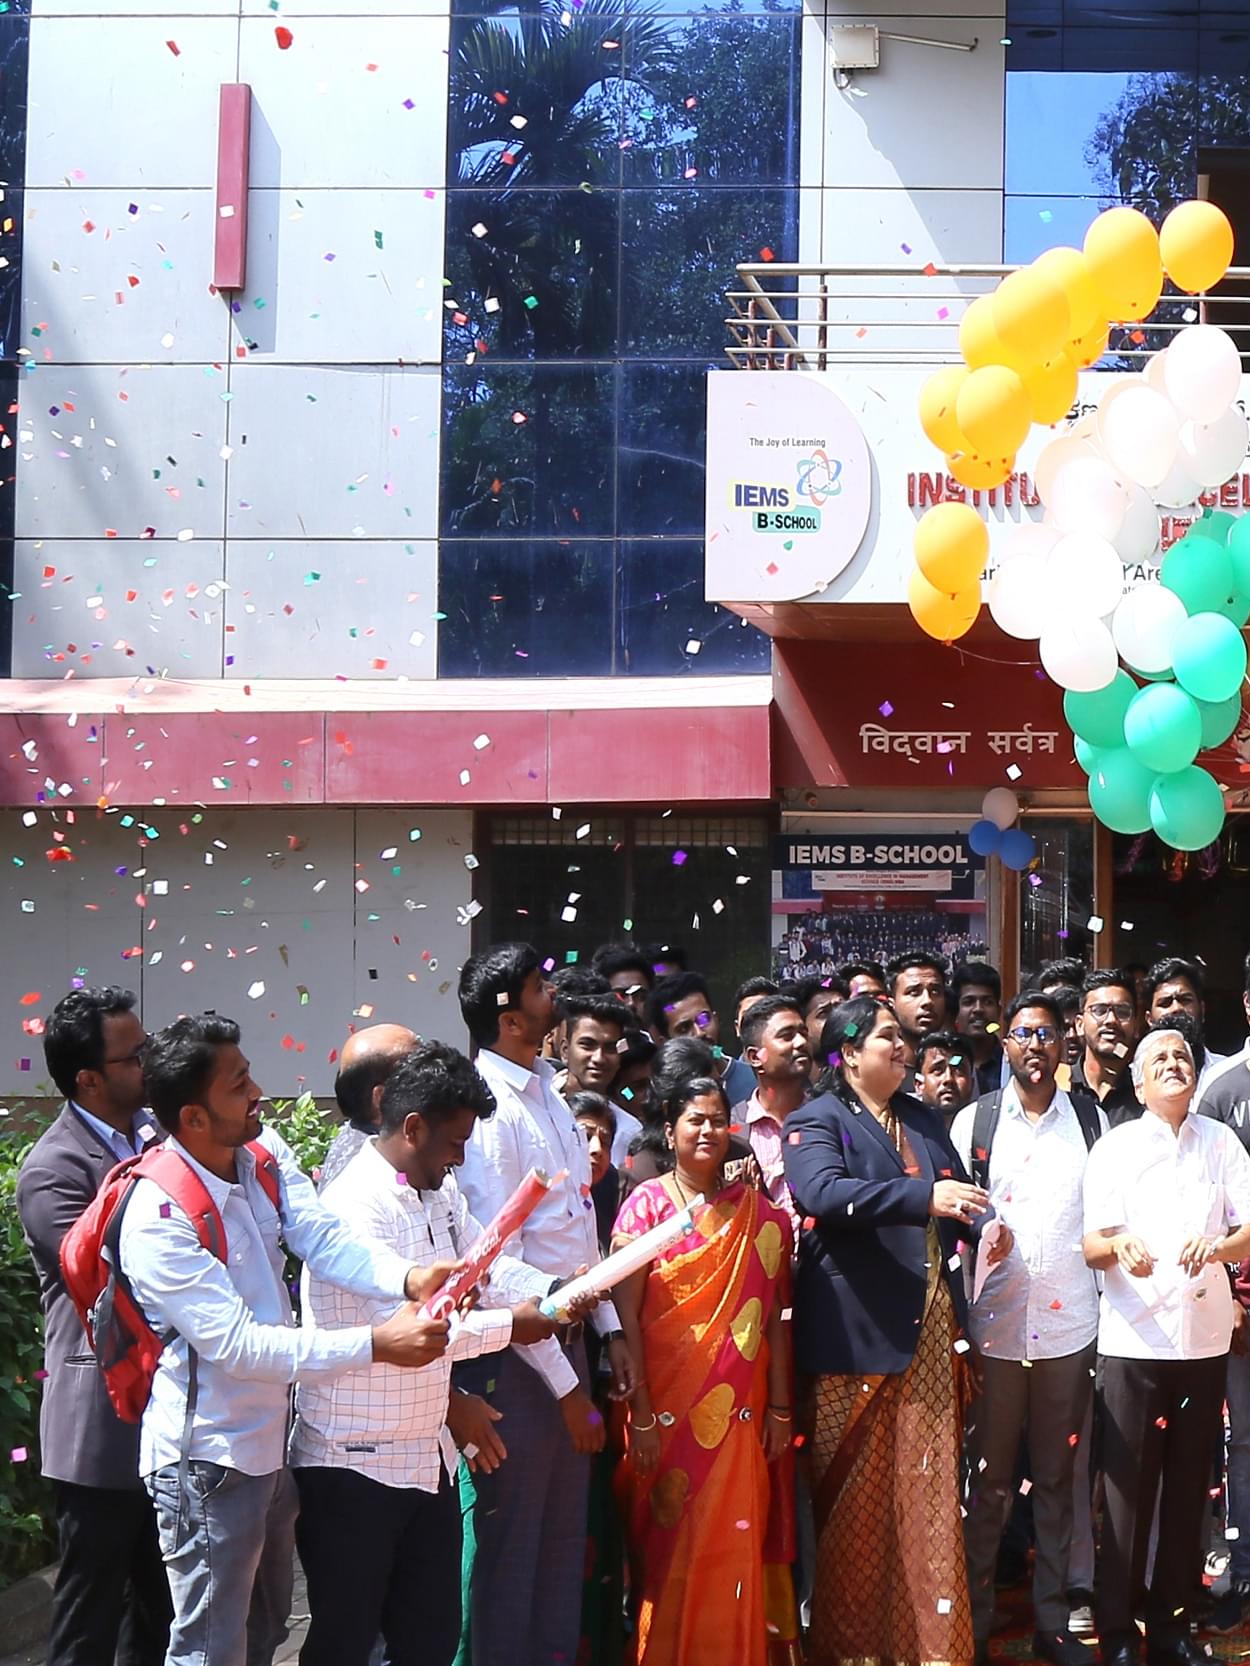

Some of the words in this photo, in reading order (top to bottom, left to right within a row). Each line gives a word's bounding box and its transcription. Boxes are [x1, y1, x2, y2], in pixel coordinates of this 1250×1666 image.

[750, 437, 764, 447] The
[766, 438, 780, 448] Joy
[782, 438, 790, 447] of
[791, 437, 826, 448] Learning
[735, 483, 790, 507] IEMS
[757, 512, 817, 529] B-SCHOOL
[987, 723, 1059, 754] सर्वत्र
[789, 845, 845, 864] IEMS
[850, 845, 969, 864] B-SCHOOL
